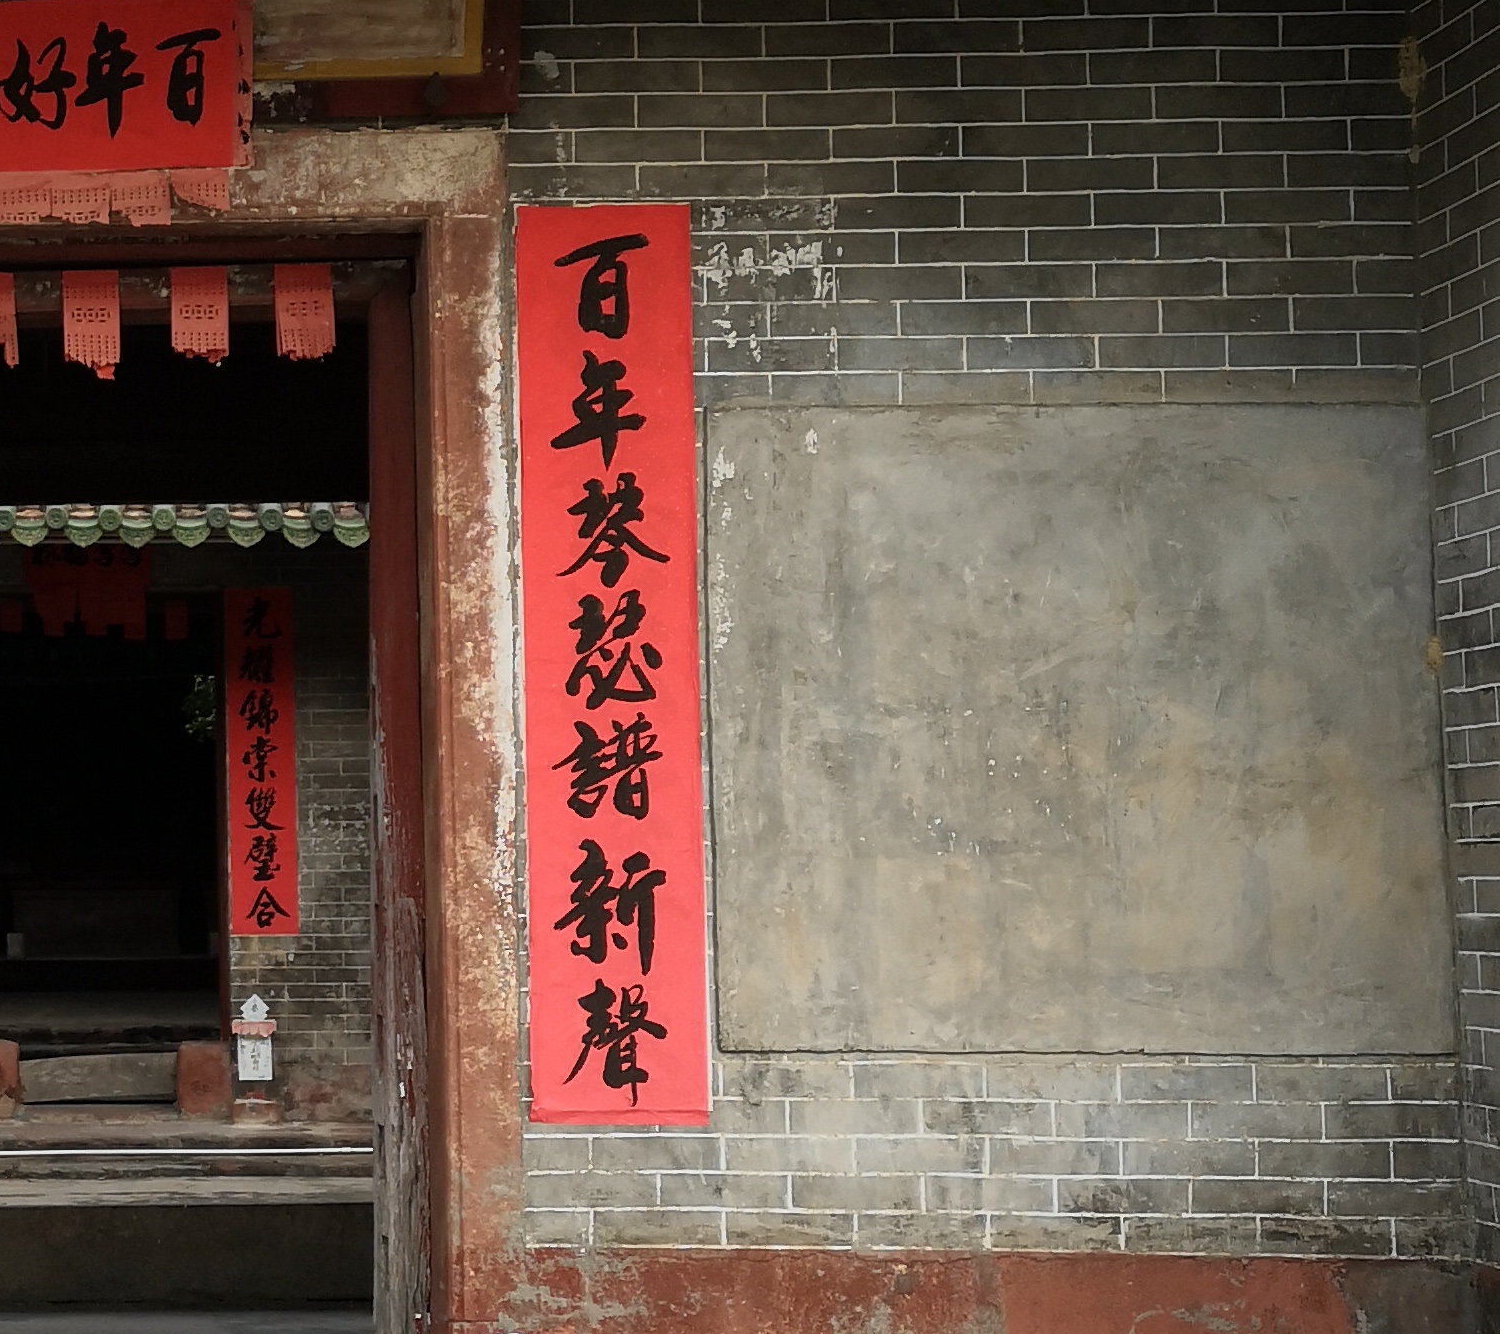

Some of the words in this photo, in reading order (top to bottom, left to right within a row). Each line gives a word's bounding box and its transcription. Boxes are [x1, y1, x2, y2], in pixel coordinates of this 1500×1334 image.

[549, 232, 671, 1108] 百年琴瑟譜新聲
